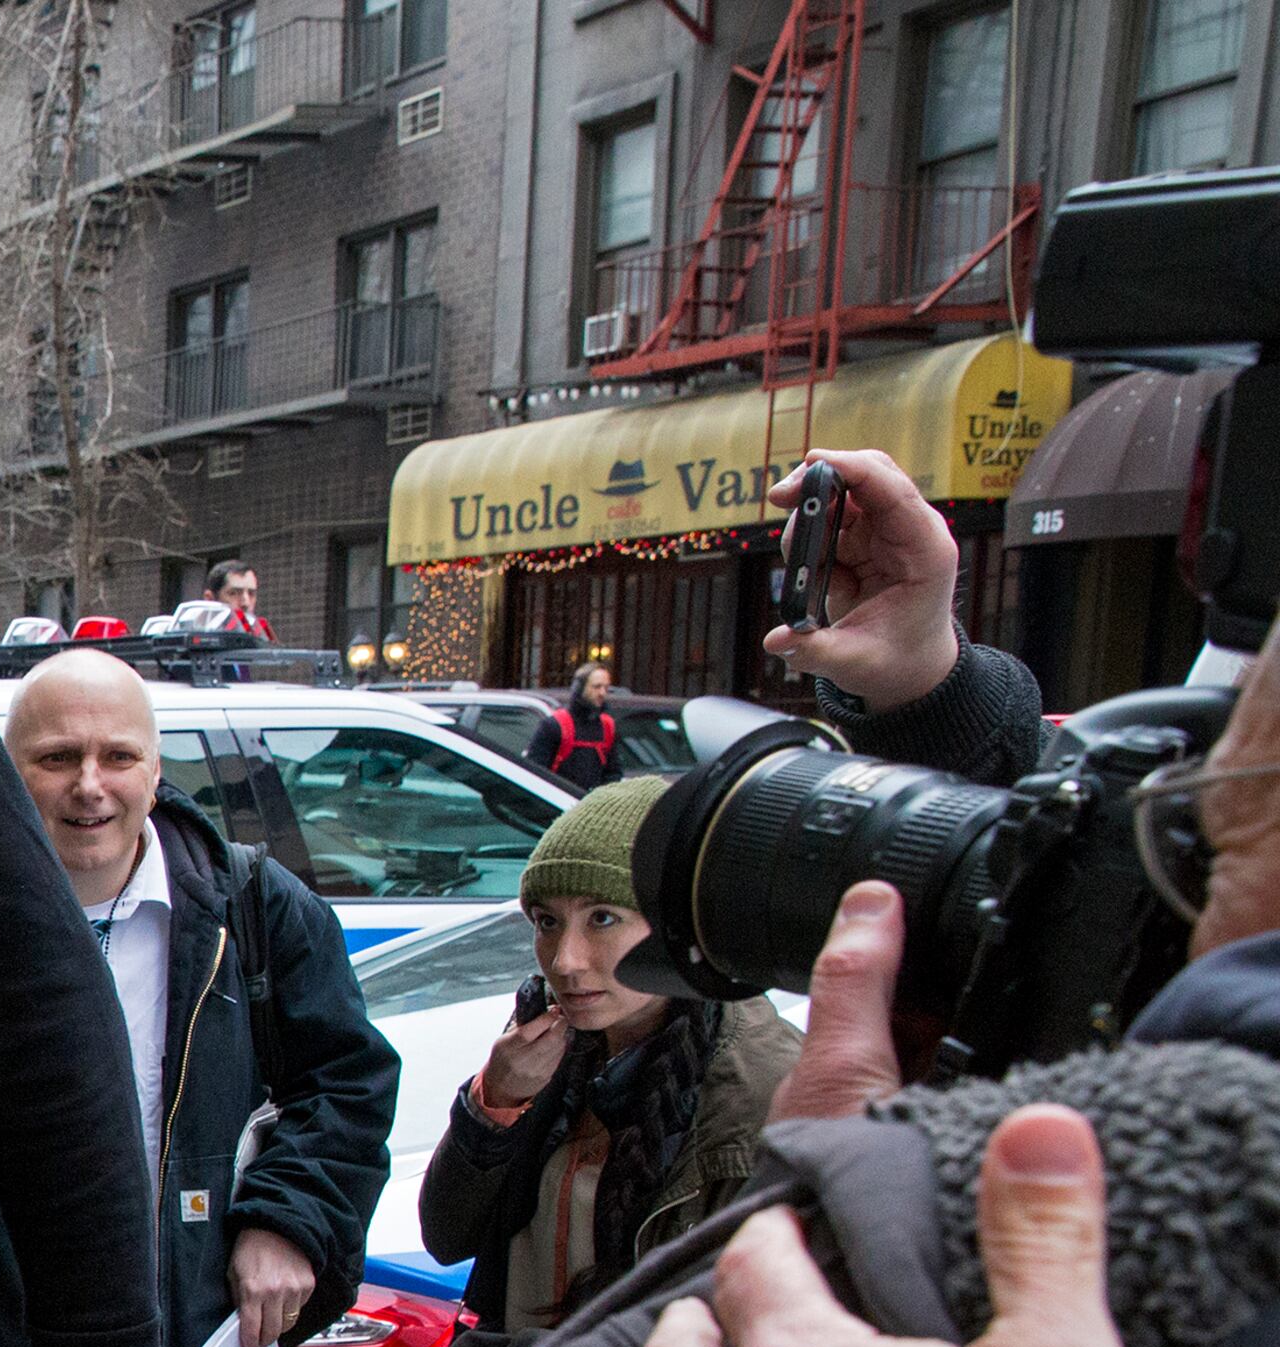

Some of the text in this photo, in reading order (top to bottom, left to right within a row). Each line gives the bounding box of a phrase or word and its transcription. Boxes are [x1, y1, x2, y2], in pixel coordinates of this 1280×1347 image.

[969, 414, 1043, 440] Uncle
[963, 442, 1035, 471] Vany
[451, 483, 580, 540] Uncle
[676, 457, 805, 512] Van
[1032, 509, 1065, 535] 315
